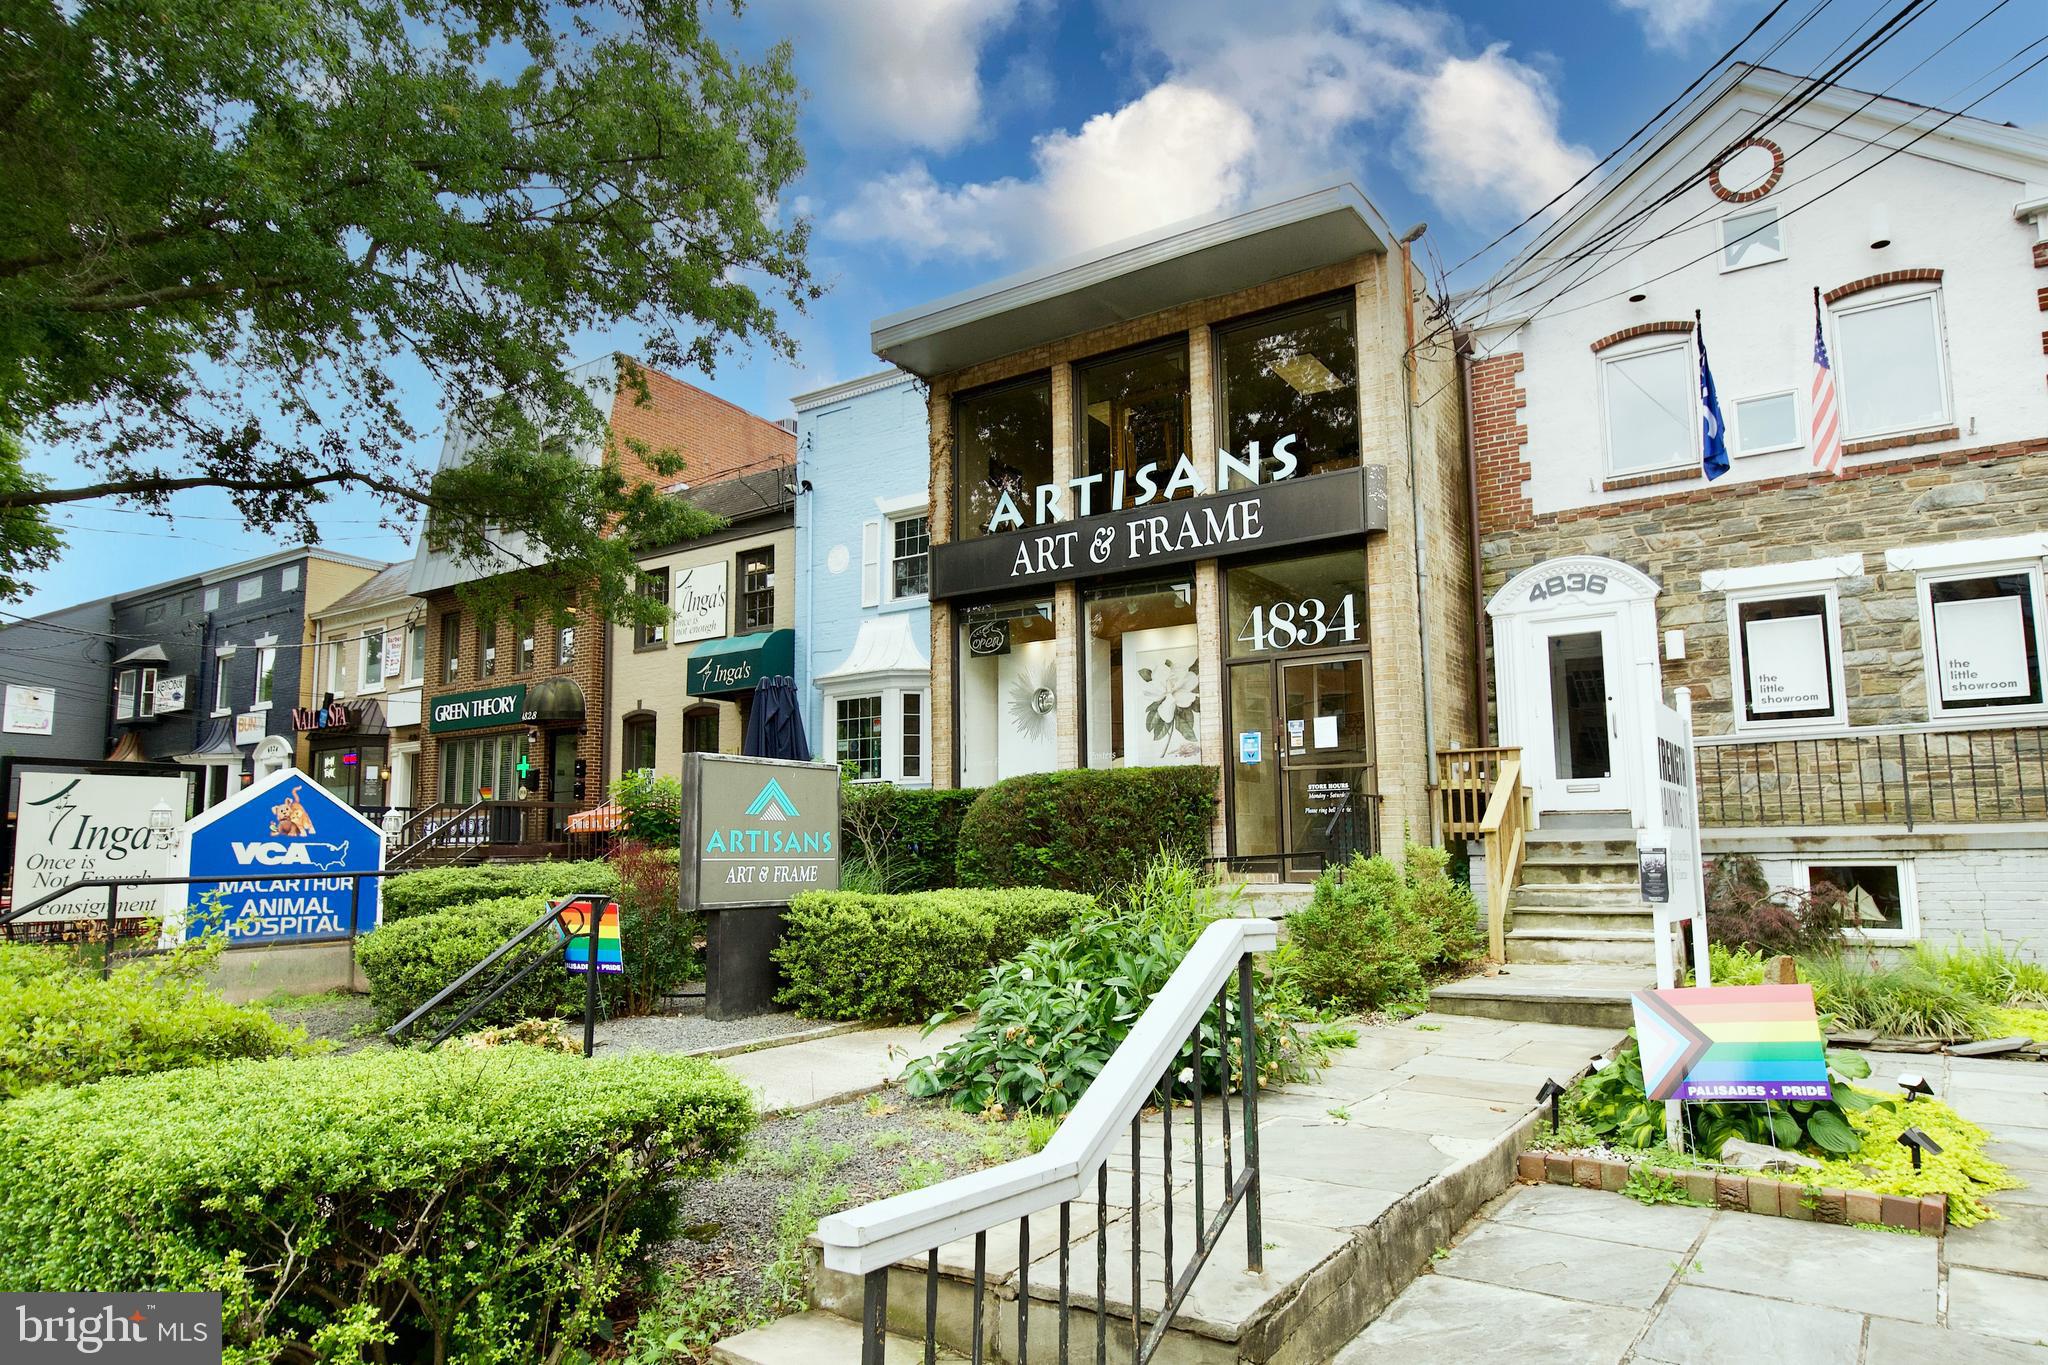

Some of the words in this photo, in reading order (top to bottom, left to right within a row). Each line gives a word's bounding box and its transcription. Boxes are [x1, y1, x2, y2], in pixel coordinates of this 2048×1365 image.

[988, 434, 1298, 532] ARTISANS
[1010, 531, 1079, 577] ART
[1089, 526, 1116, 564] &
[1126, 498, 1264, 559] FRAME
[1529, 573, 1608, 602] 4836
[687, 584, 726, 616] Inga's
[1237, 593, 1361, 652] 4834
[713, 660, 751, 685] Inga's
[1949, 659, 1970, 668] the
[1759, 674, 1778, 682] the
[1950, 670, 1978, 680] little
[1760, 684, 1784, 693] little
[1952, 680, 2018, 691] showroom
[435, 702, 469, 722] GREEN
[472, 695, 517, 717] THEORY
[1761, 694, 1819, 704] showroom
[292, 708, 319, 731] NAIL
[328, 703, 347, 727] SPA
[1657, 736, 1688, 787] TRENGTH
[1329, 791, 1347, 799] Saturd
[69, 814, 169, 861] Inga
[706, 829, 832, 853] ARTISANS
[27, 853, 76, 870] Once
[81, 854, 96, 870] is
[231, 842, 311, 865] VCA
[32, 872, 71, 888] Not
[724, 866, 756, 884] ART
[758, 866, 769, 882] &
[773, 865, 818, 882] FRAME
[218, 877, 353, 894] MACARTHUR
[239, 897, 334, 917] ANIMAL
[224, 915, 345, 937] HOSPITAL
[601, 963, 623, 972] PRIDE
[1688, 1085, 1766, 1096] PALISADES
[1782, 1085, 1827, 1097] PRIDE
